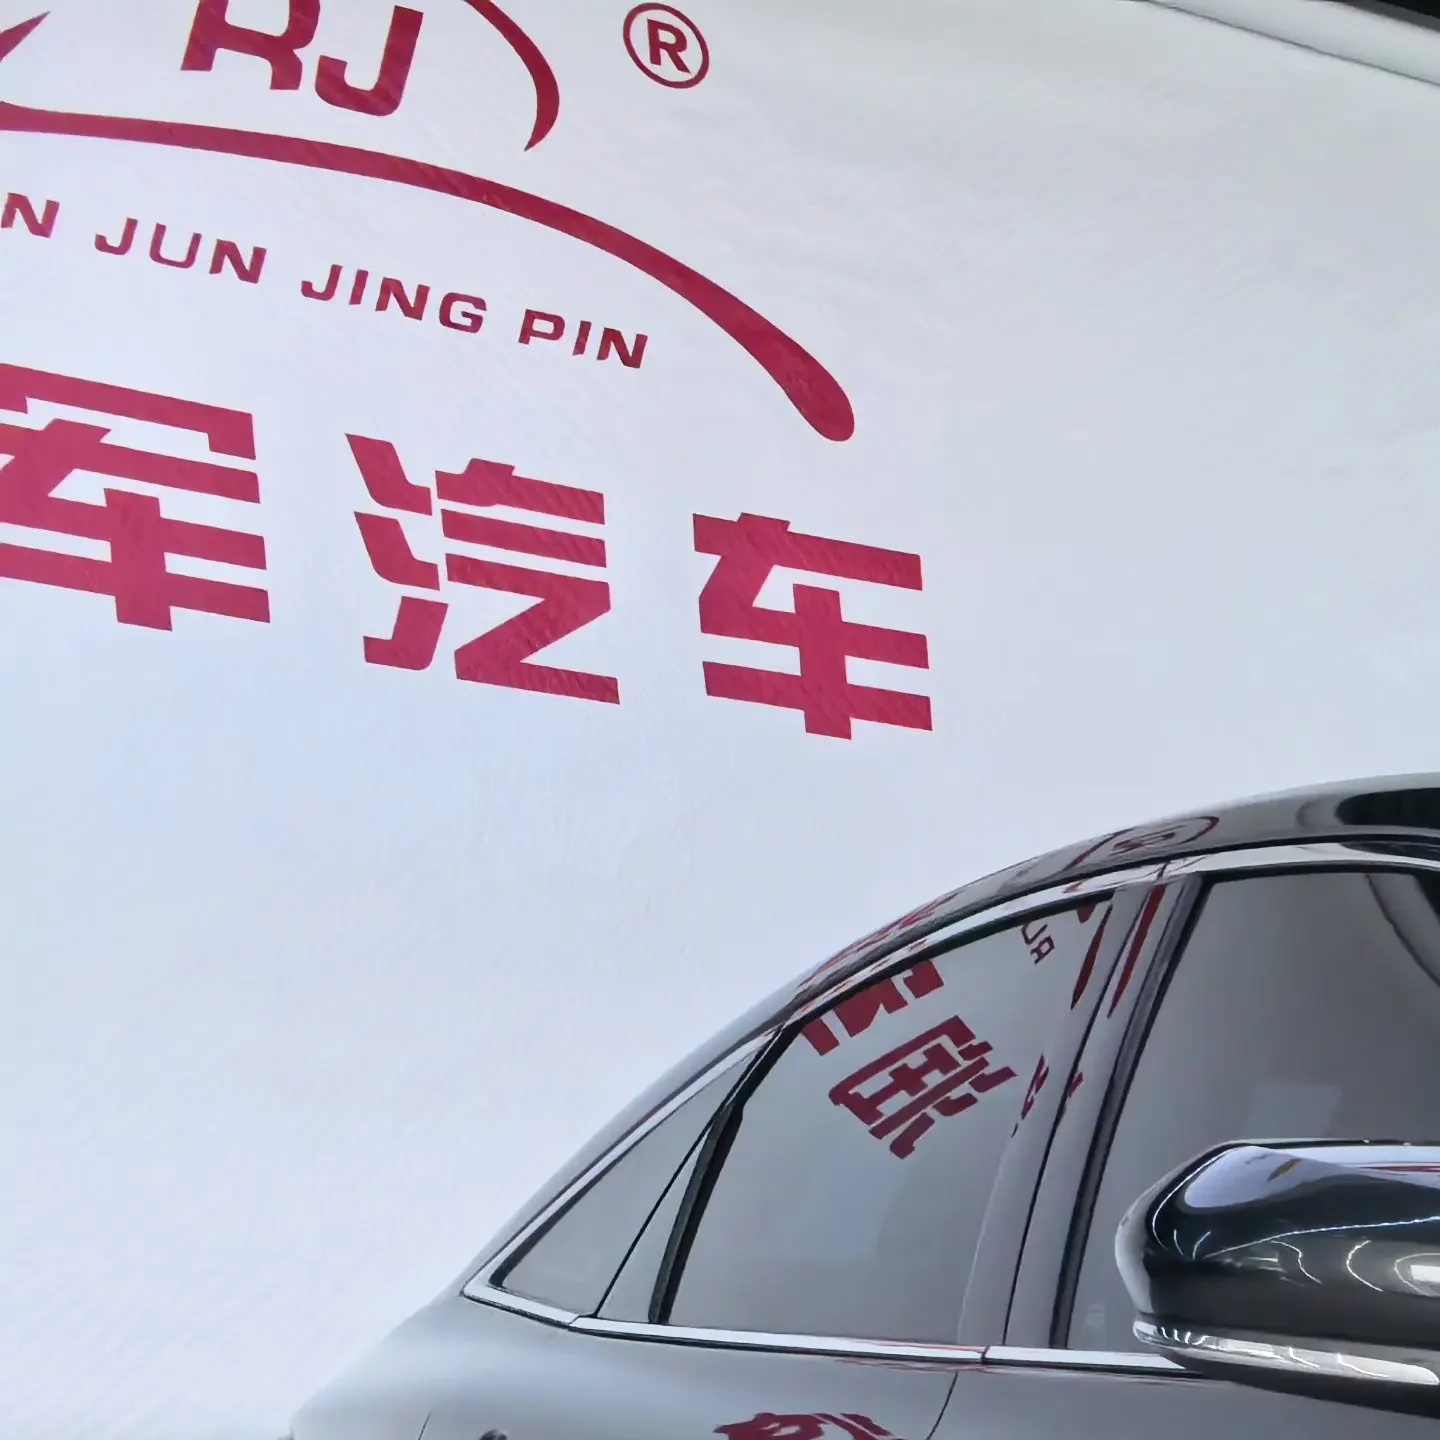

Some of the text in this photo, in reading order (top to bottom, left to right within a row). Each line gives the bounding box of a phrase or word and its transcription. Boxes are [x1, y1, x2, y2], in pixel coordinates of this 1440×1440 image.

[94, 217, 267, 284] JUN
[301, 264, 488, 334] JING
[519, 309, 648, 369] PIN
[0, 363, 933, 741] 军汽车
